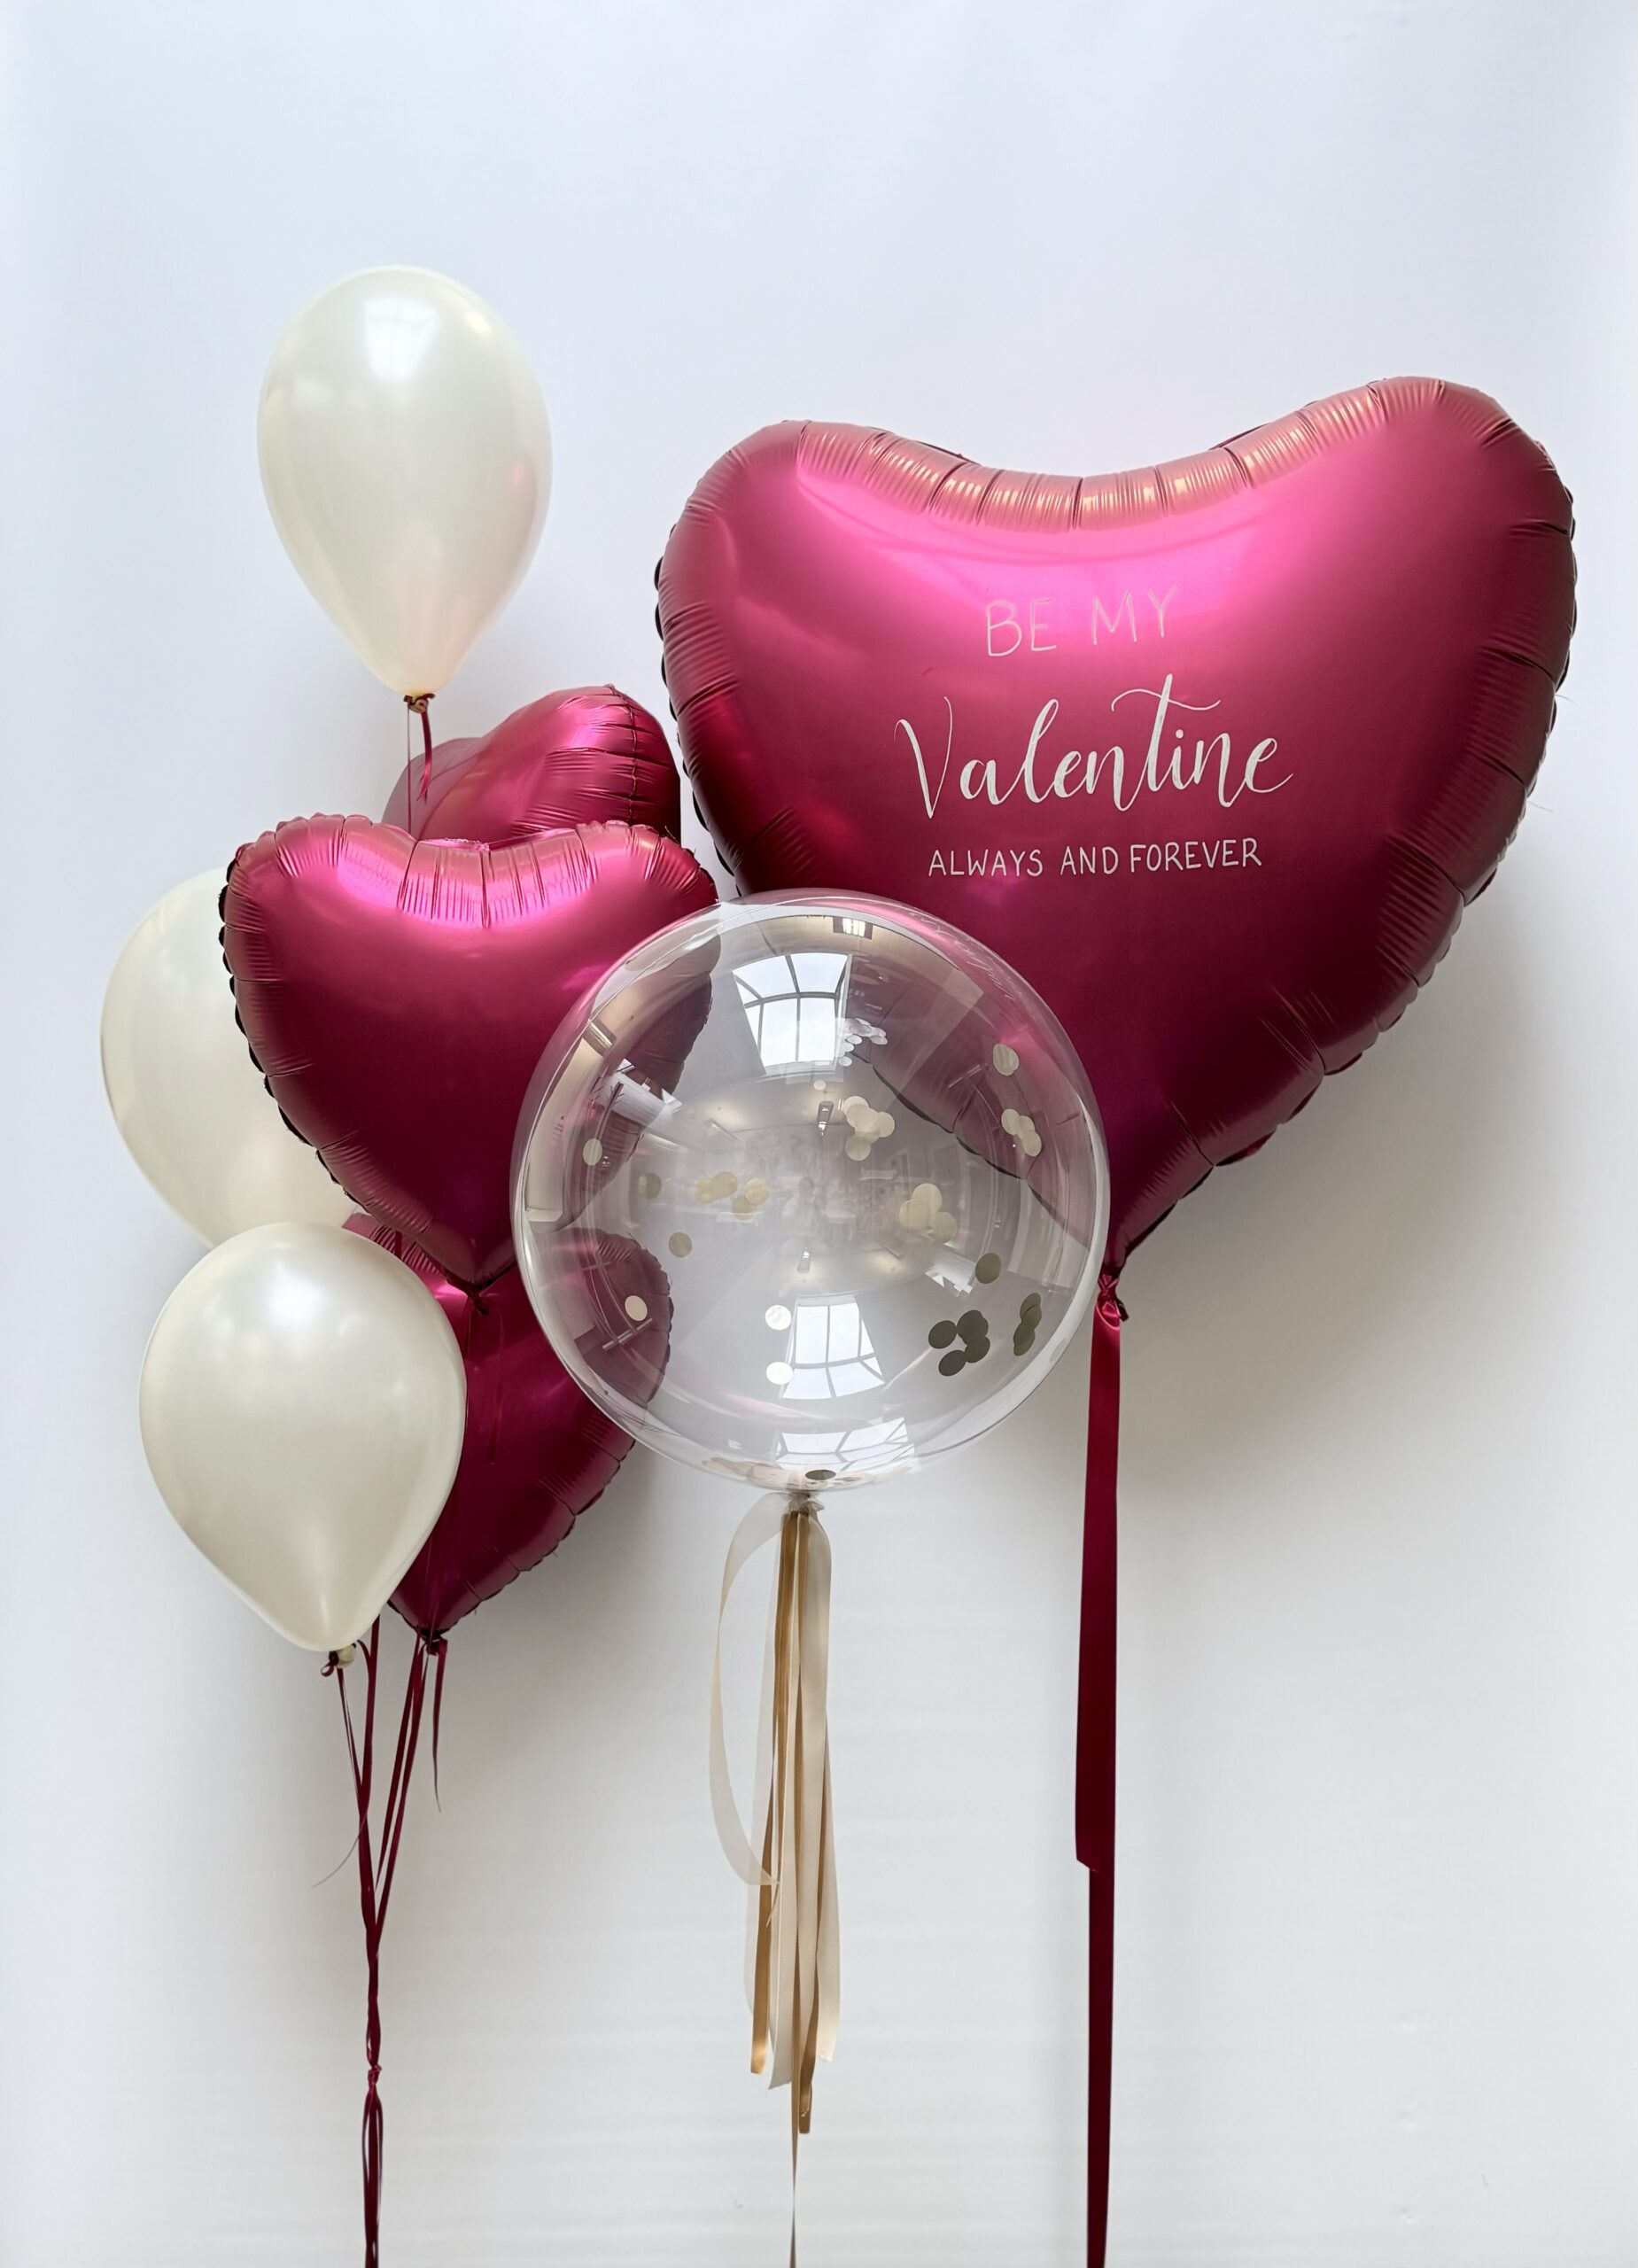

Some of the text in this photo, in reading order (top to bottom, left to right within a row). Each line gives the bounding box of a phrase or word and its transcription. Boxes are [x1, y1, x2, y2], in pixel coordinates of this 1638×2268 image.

[985, 584, 1178, 657] BE MY
[893, 673, 1294, 819] Valentine
[928, 837, 1262, 877] ALWAYS AND FOREVER
